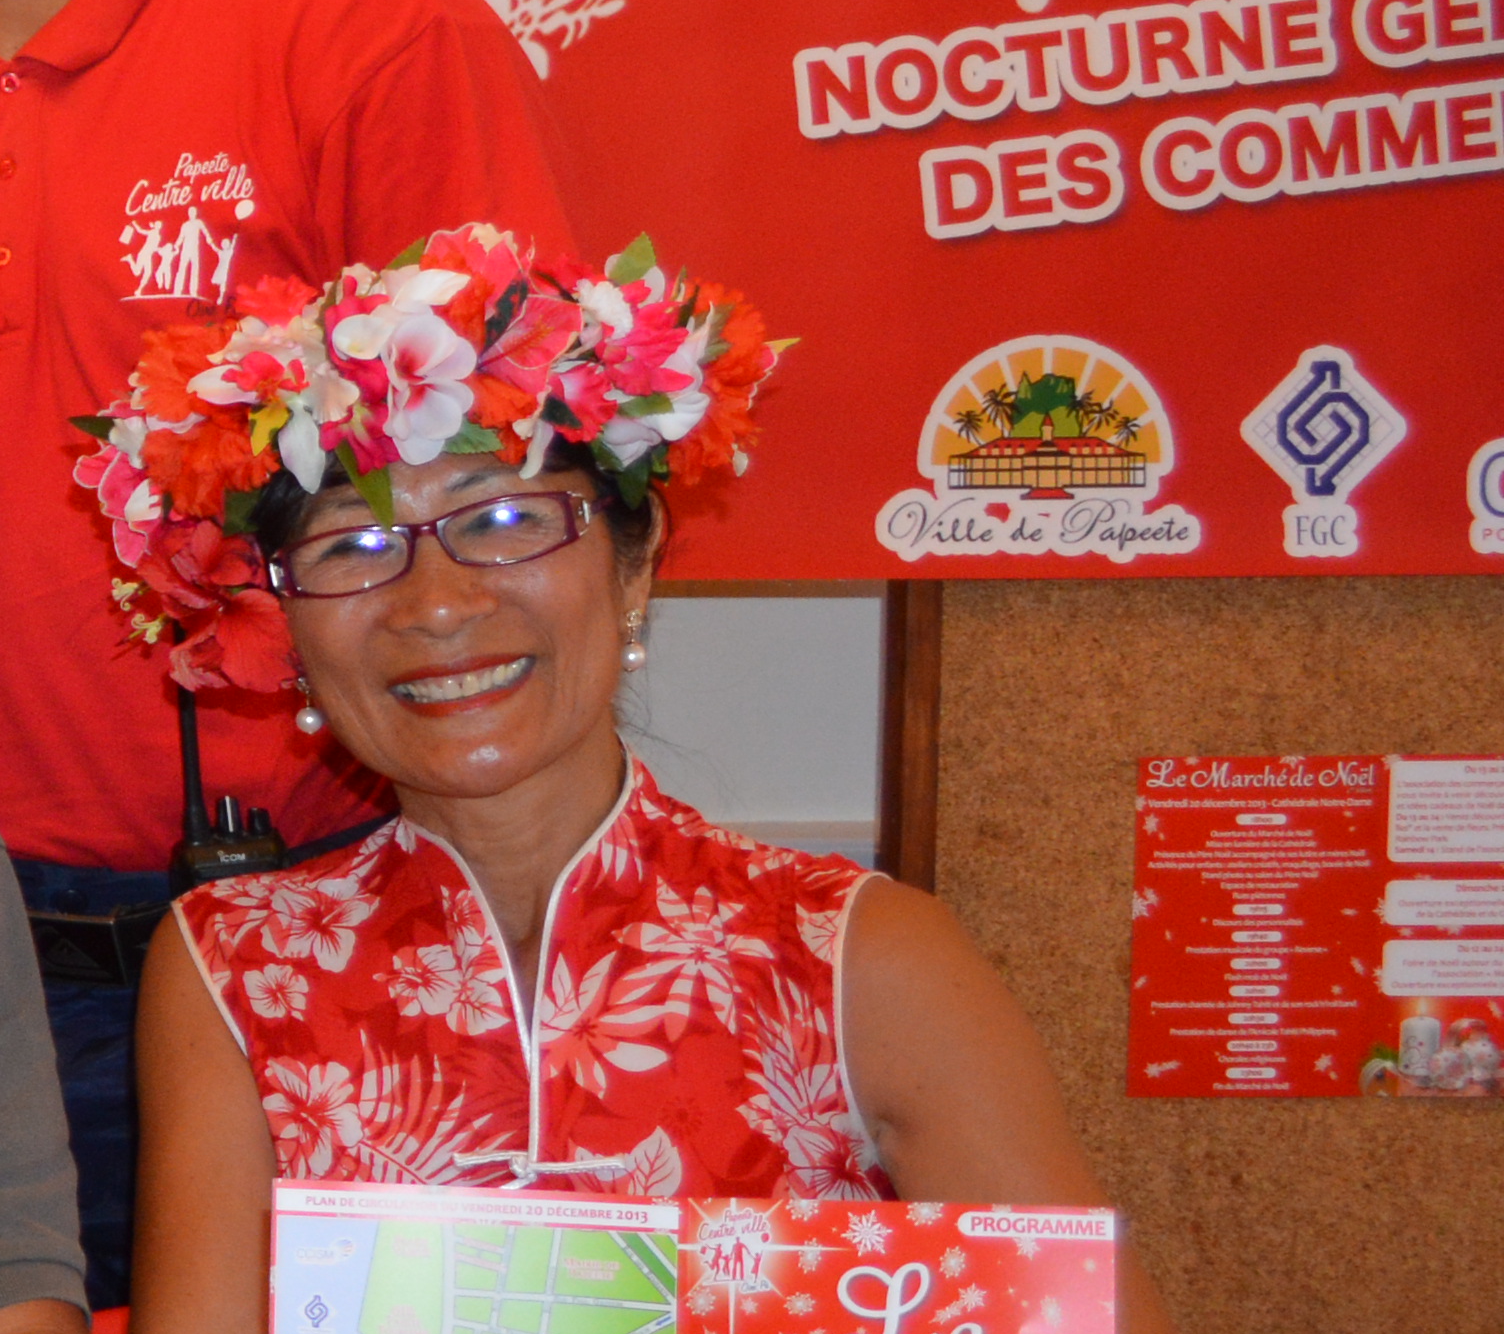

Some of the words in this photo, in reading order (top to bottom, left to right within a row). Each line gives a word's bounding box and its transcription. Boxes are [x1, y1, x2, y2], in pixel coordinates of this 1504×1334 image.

[174, 151, 231, 184] Papeete
[931, 140, 1111, 227] DES
[125, 179, 193, 216] Centre
[201, 163, 255, 202] ville
[888, 498, 994, 546] Ville
[1009, 518, 1043, 542] de
[1059, 498, 1190, 551] Papeete
[1296, 514, 1347, 547] FGC
[1146, 759, 1186, 788] Le
[1190, 761, 1287, 788] Marché
[1290, 763, 1313, 787] de
[1318, 761, 1375, 787] Noël
[305, 1195, 337, 1208] PLAN
[339, 1197, 355, 1208] DE
[462, 1202, 522, 1215] VENDREDI
[525, 1205, 543, 1216] 20
[547, 1202, 612, 1220] DÉCEMBRE
[616, 1209, 648, 1224] 2013
[968, 1214, 1106, 1238] PROGRAMME
